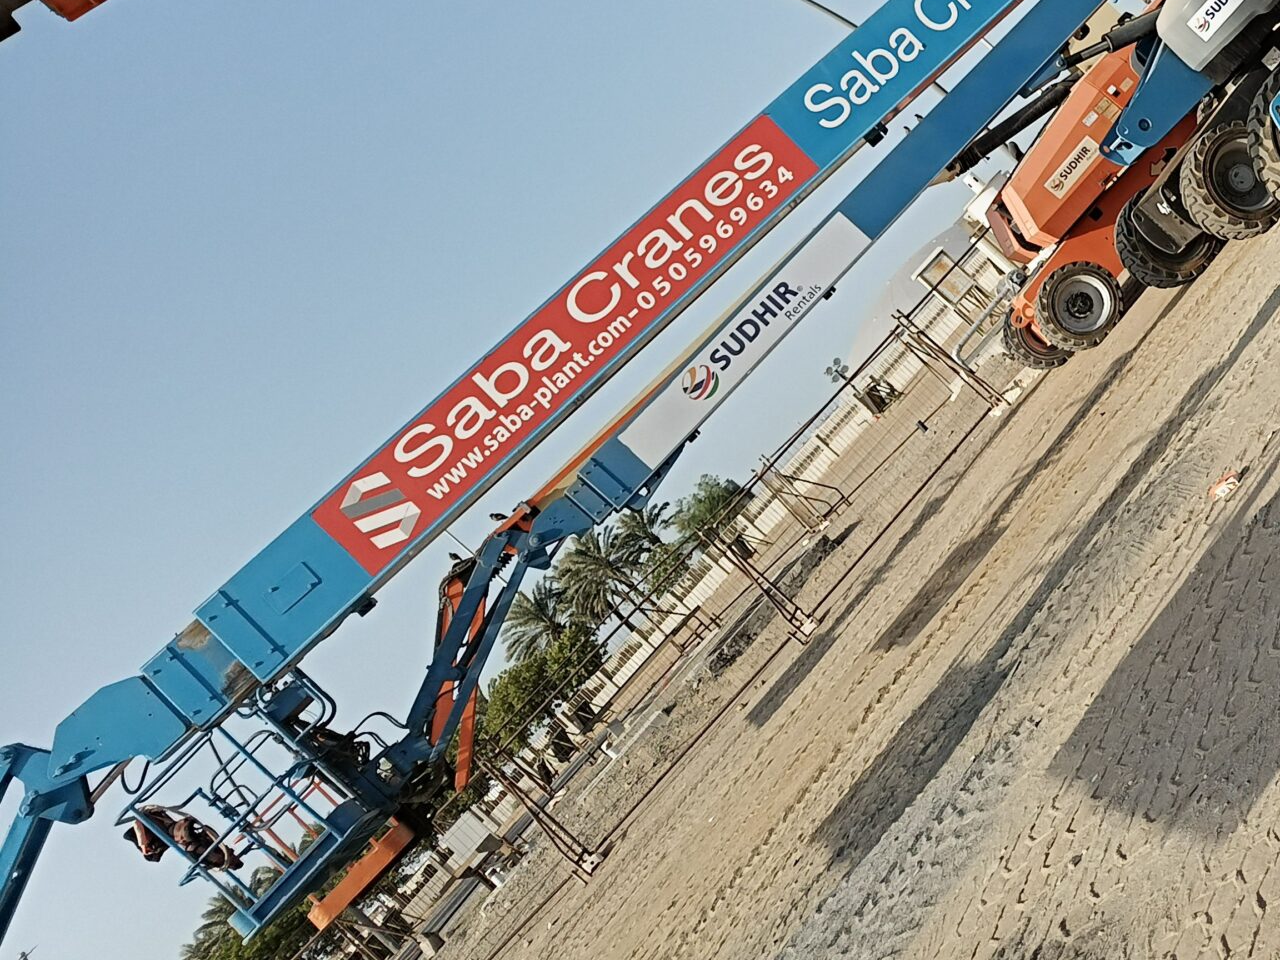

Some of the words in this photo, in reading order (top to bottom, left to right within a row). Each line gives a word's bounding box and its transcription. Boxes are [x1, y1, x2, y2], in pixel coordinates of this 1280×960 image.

[804, 28, 924, 128] Saba
[1060, 146, 1091, 180] SUDHIR
[394, 329, 572, 477] Saba
[567, 144, 773, 323] Cranes
[710, 282, 799, 371] SUDHIR
[784, 285, 822, 321] Rentals
